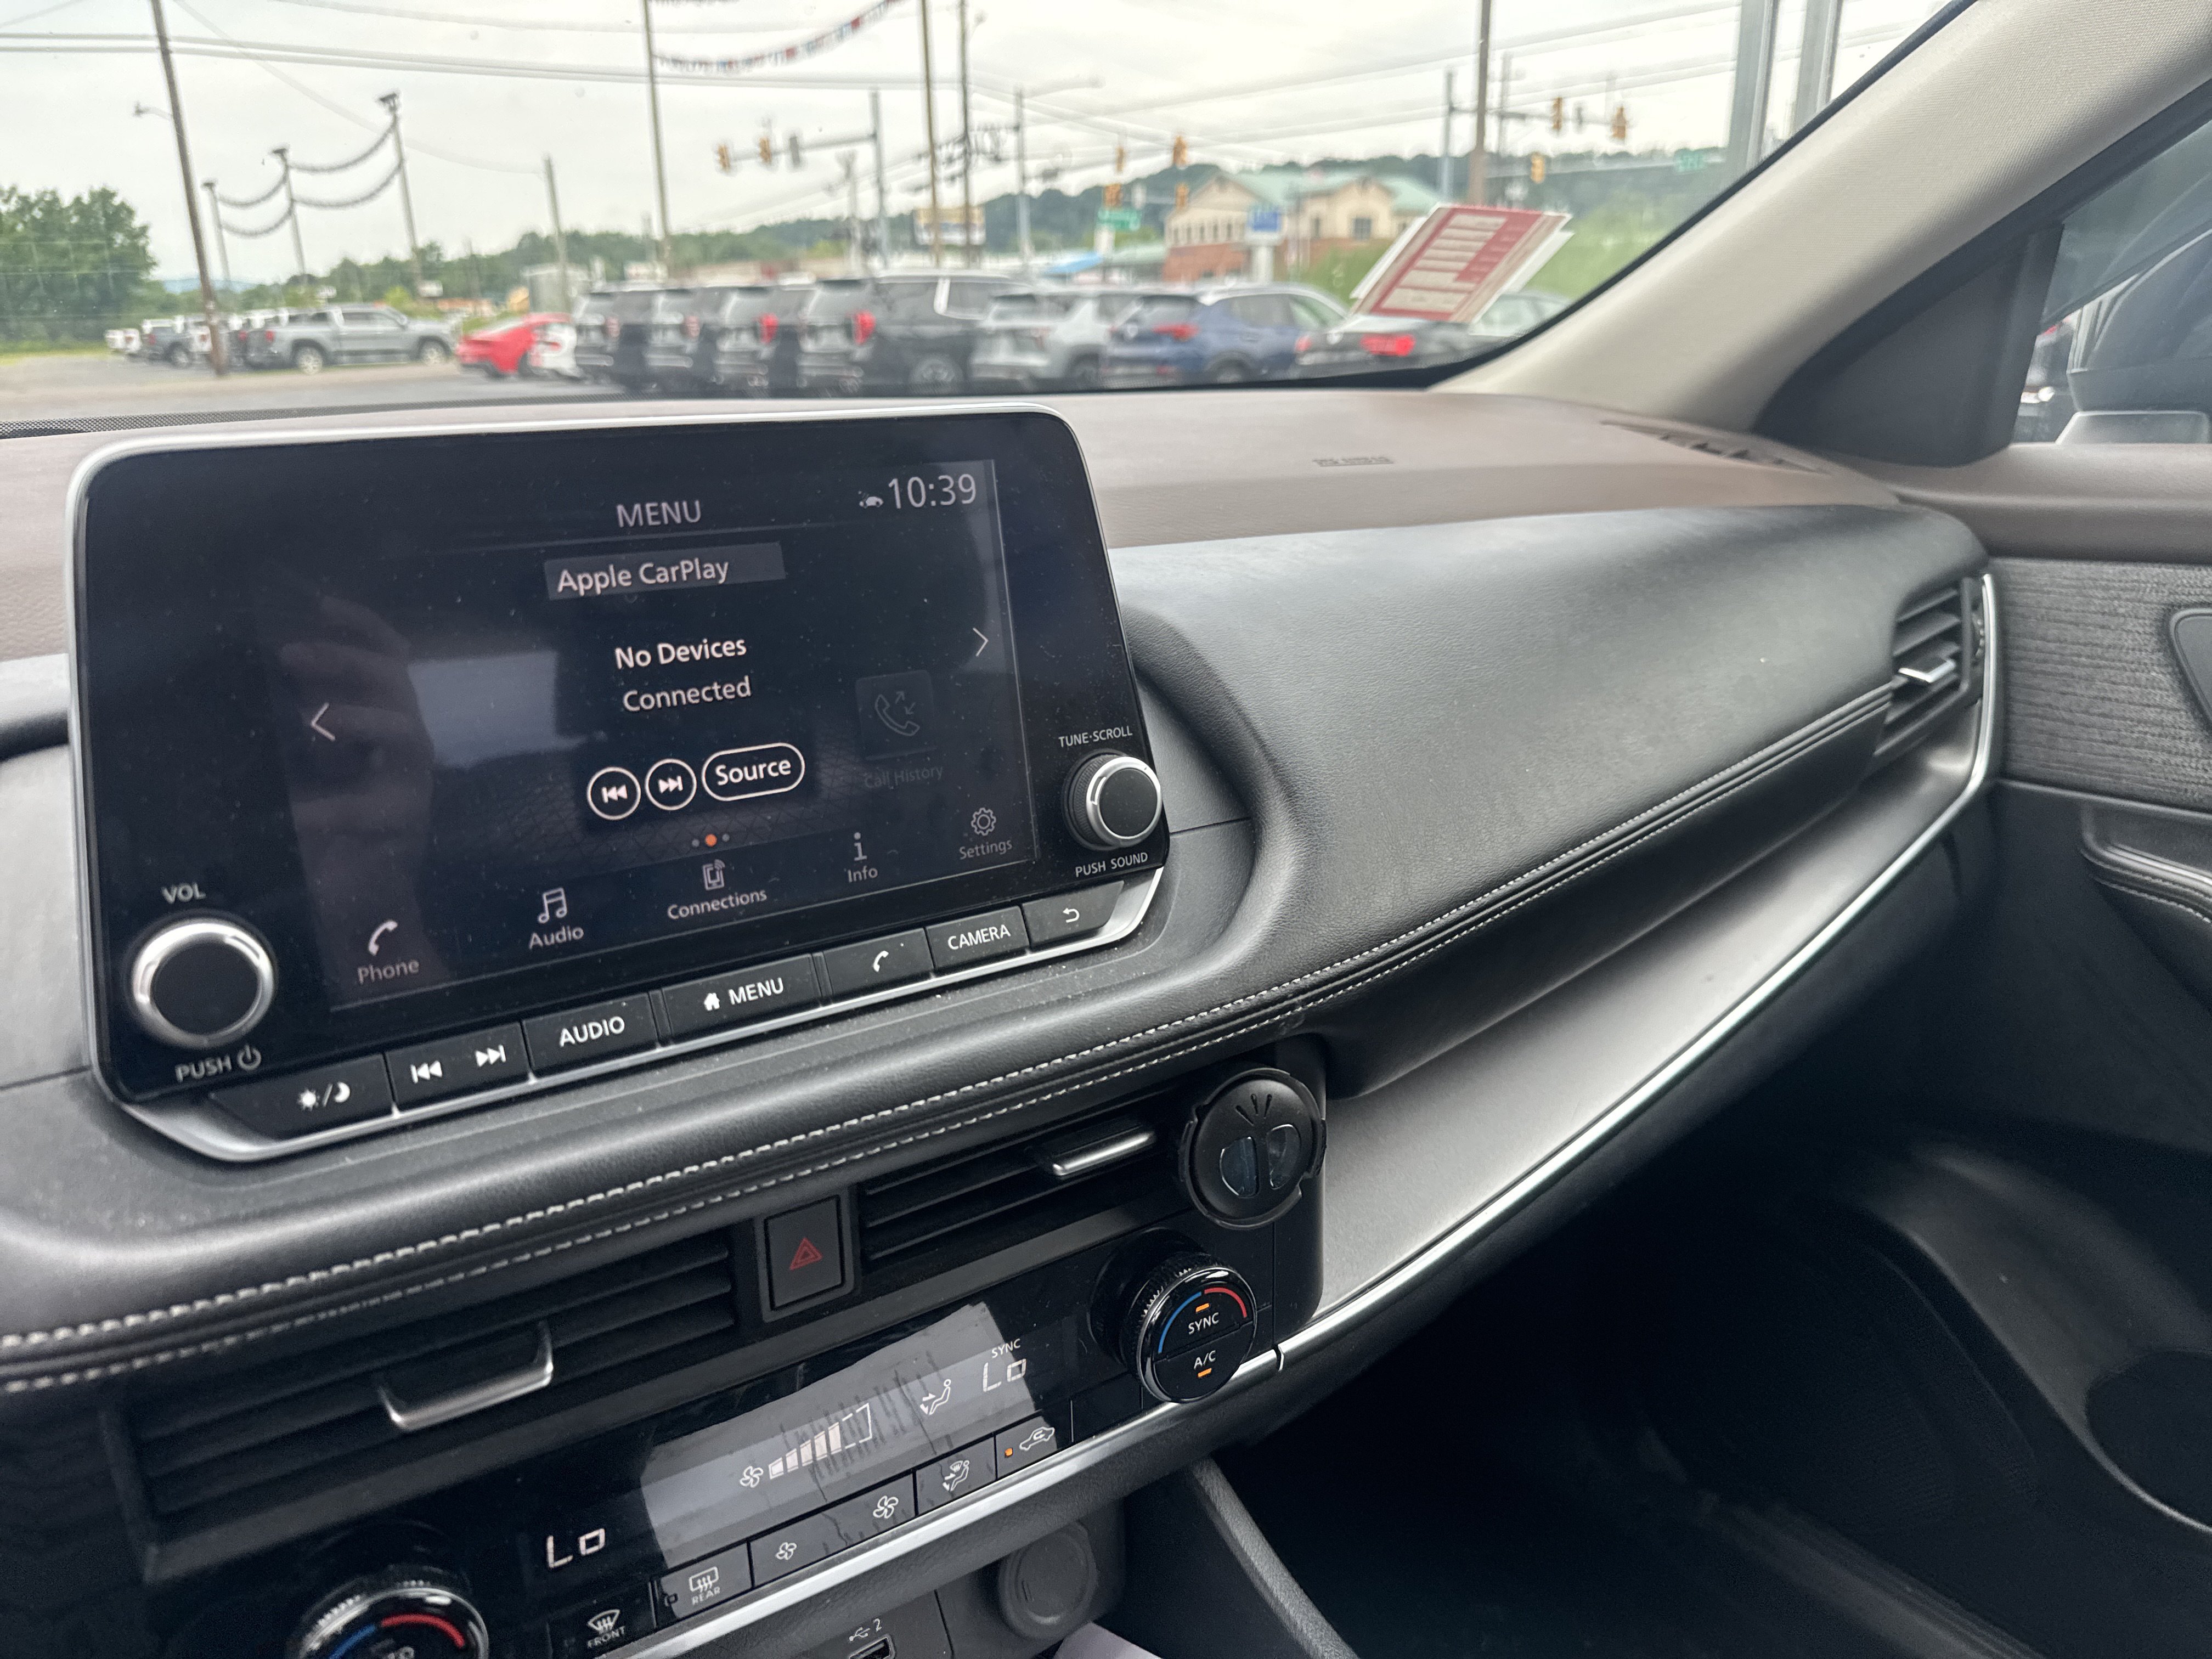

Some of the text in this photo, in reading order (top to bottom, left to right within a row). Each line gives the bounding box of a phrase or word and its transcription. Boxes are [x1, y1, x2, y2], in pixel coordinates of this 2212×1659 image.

[888, 473, 977, 509] 10:39
[616, 500, 702, 528] MENU
[556, 557, 730, 596] Apple CarPlay
[614, 634, 747, 670] No Devices
[623, 676, 752, 713] Connected
[715, 757, 792, 787] Source
[864, 766, 944, 788] Call History
[958, 838, 1013, 860] Settings
[847, 866, 878, 883] Info
[1075, 852, 1149, 878] PUSH SOUND
[161, 882, 206, 904] VOL
[667, 889, 768, 920] Connections
[528, 924, 584, 950] Audio
[947, 924, 1011, 951] CAMERA
[357, 958, 420, 985] Phone
[728, 977, 785, 1006] MENU
[558, 1015, 626, 1047] AUDIO
[174, 1053, 232, 1082] PUSH
[1188, 1312, 1220, 1335] SYNC
[991, 1338, 1022, 1358] SYNC
[1193, 1348, 1217, 1369] A/C
[692, 1585, 721, 1606] REAR
[586, 1625, 627, 1649] FRONT
